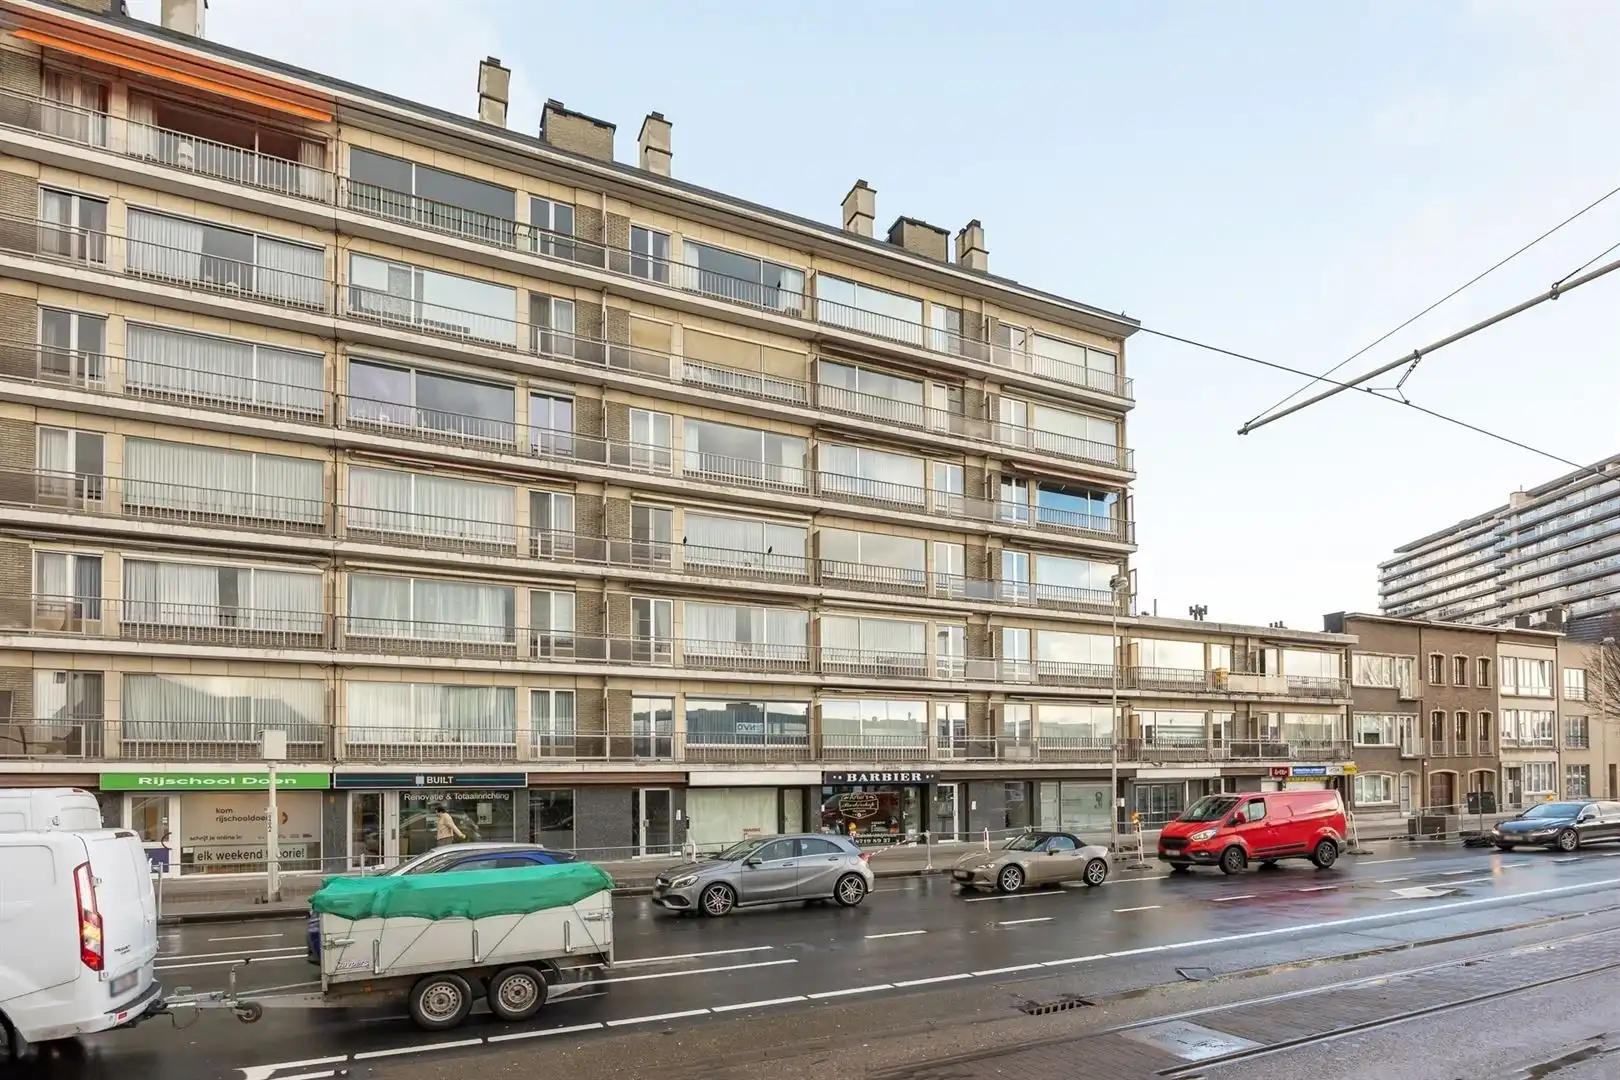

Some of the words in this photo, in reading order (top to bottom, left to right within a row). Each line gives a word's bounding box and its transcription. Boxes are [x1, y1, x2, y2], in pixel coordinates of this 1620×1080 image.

[138, 777, 235, 786] Rijschool
[426, 776, 454, 784] BUILT
[846, 772, 922, 782] BARBIER
[403, 793, 444, 801] Renovatie
[454, 792, 509, 801] Totaalinrichting
[197, 850, 213, 861] elk
[216, 849, 263, 860] weekend
